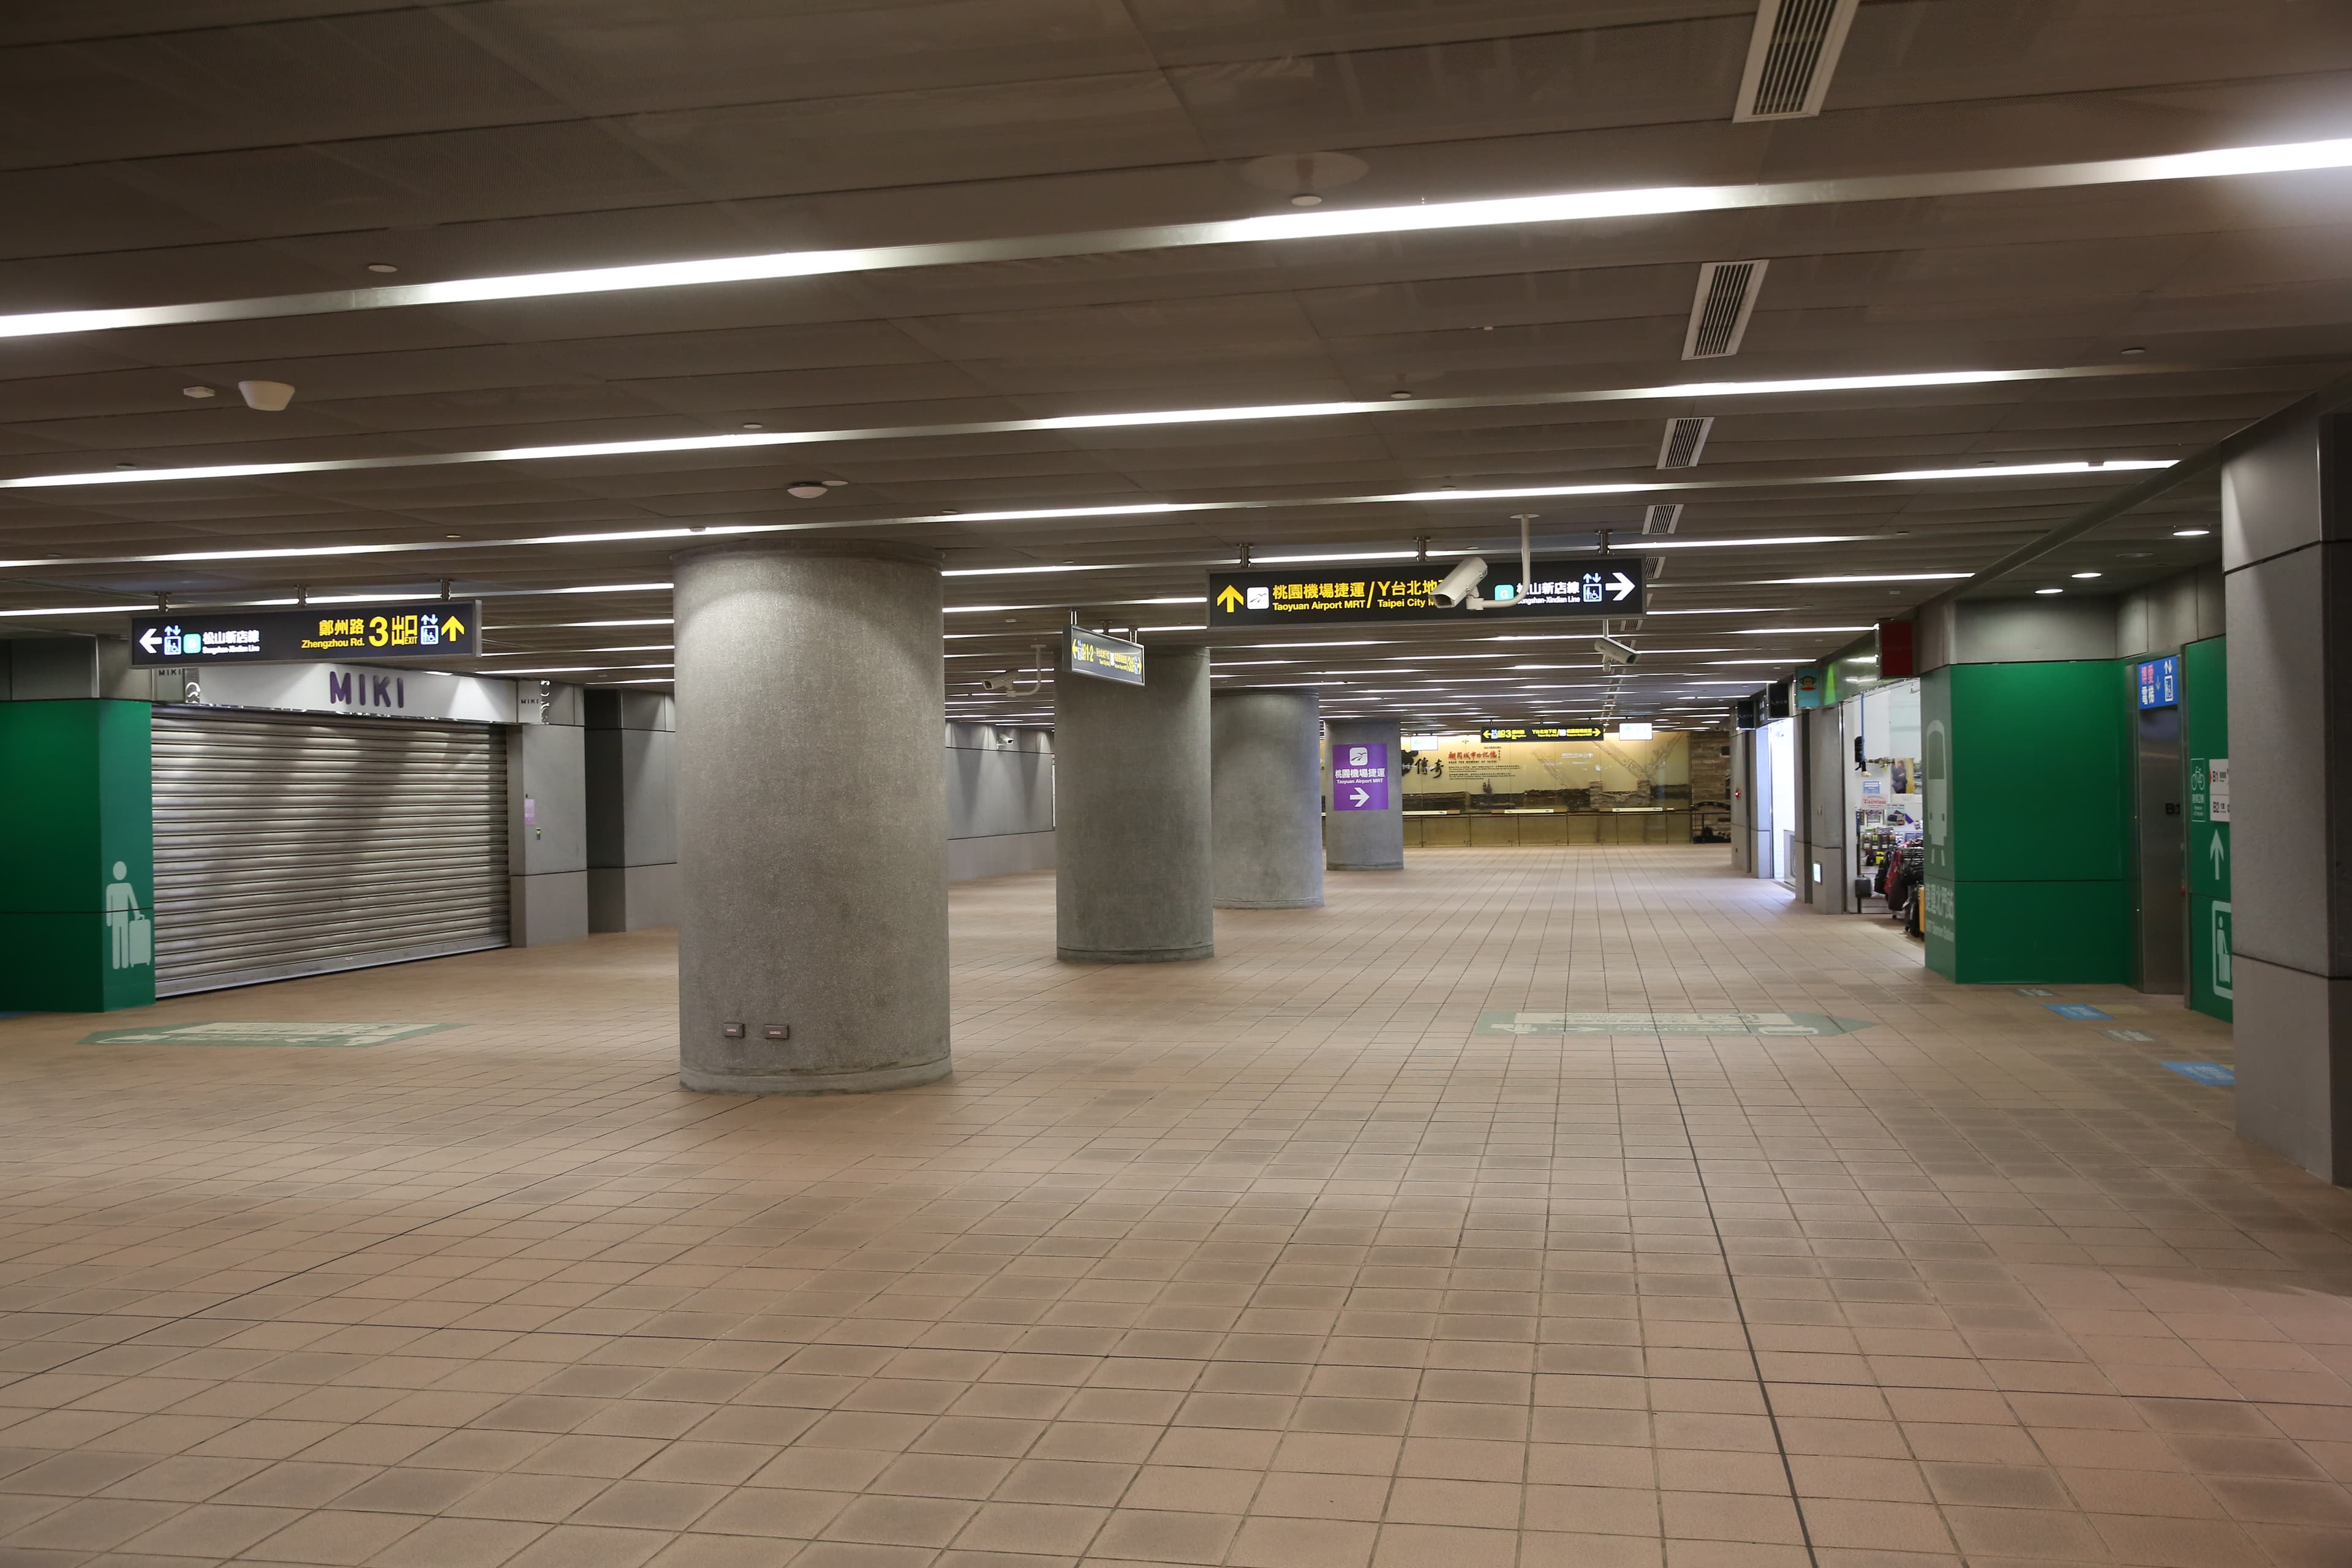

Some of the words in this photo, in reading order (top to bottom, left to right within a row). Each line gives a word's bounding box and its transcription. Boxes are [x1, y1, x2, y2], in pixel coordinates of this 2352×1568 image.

[1272, 582, 1365, 600] 桃園機場捷運
[1500, 590, 1509, 598] G
[1272, 601, 1310, 612] Taoyuan
[1311, 600, 1343, 610] Airport
[1344, 600, 1366, 609] MRT
[1377, 598, 1406, 609] Taipei
[1408, 597, 1427, 609] City
[1517, 596, 1567, 606] ongshan-Xindian
[318, 619, 364, 636] 鄭州路
[368, 616, 389, 647] 3
[391, 614, 418, 646] 出口
[301, 638, 349, 649] Zhengzhou
[350, 637, 365, 647] Rd.
[404, 636, 418, 644] EXIT
[330, 671, 404, 708] MIKI
[1335, 767, 1385, 778] 桃園機場捷運
[2166, 803, 2180, 815] B1
[2213, 801, 2219, 813] B2
